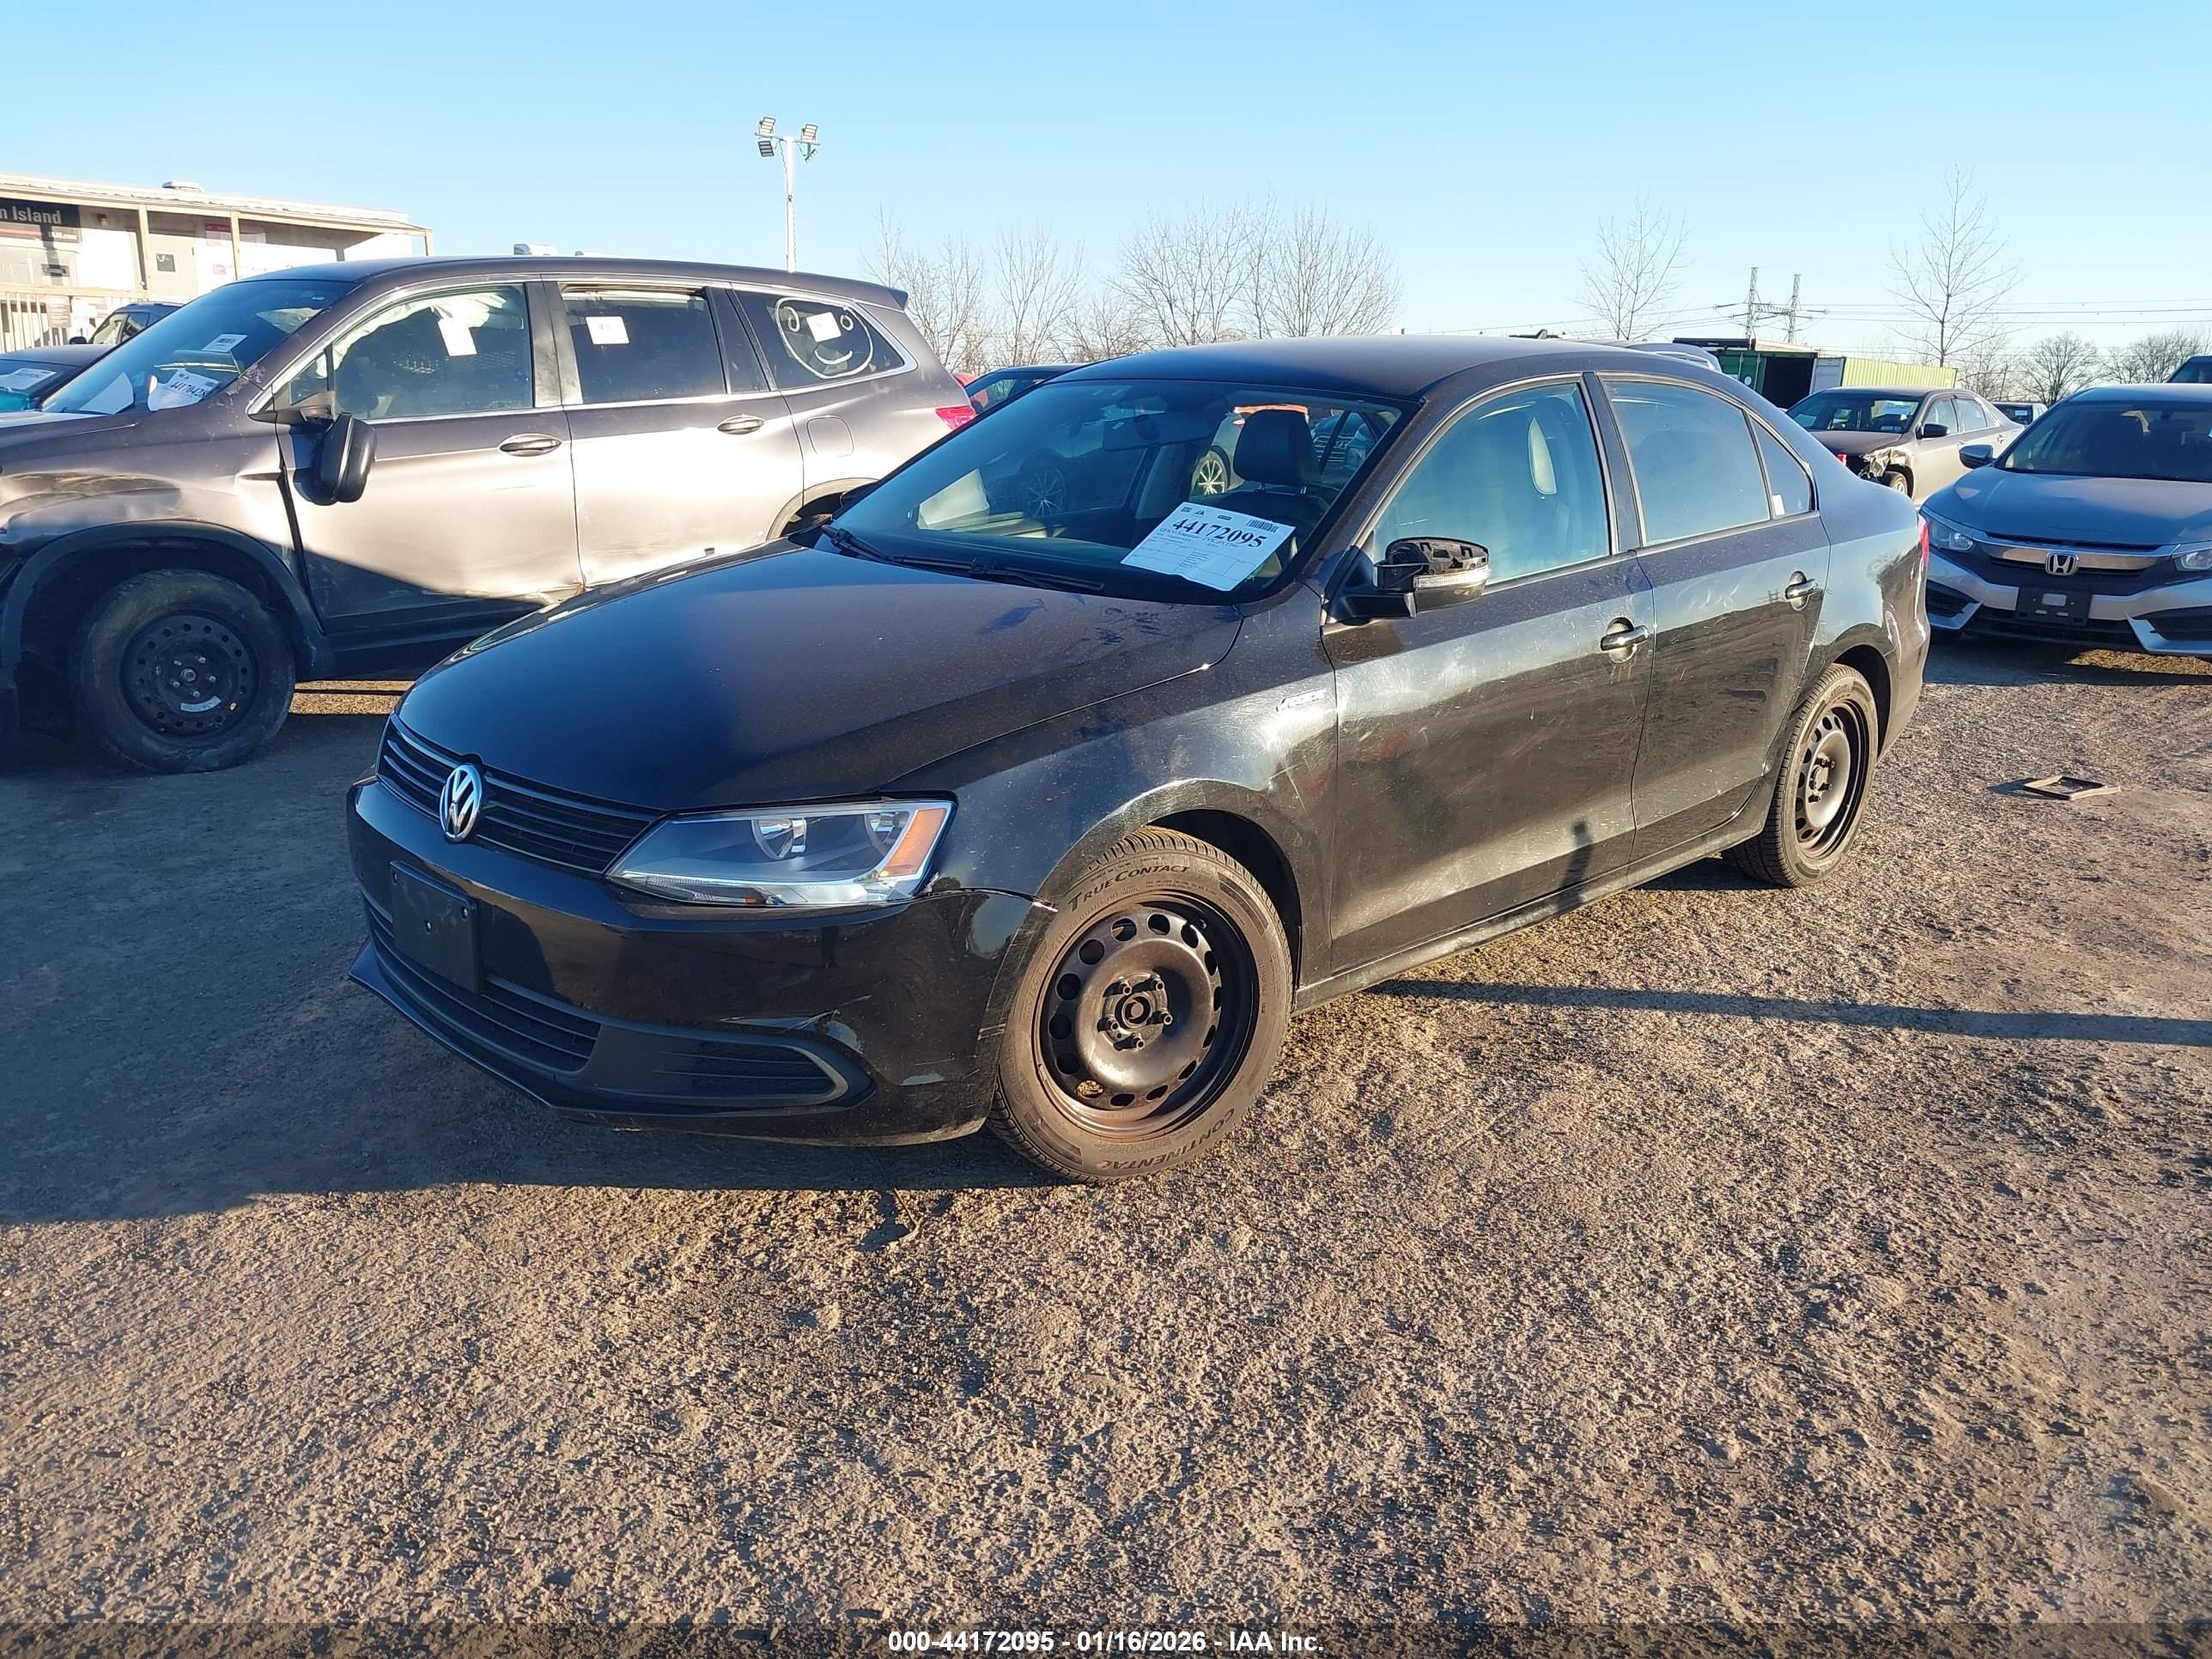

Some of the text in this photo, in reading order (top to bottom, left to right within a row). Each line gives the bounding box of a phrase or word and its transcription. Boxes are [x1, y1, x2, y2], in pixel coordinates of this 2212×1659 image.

[12, 205, 62, 225] Island
[1172, 518, 1267, 548] 44172095
[1102, 1108, 1235, 1170] CONTINENTAL
